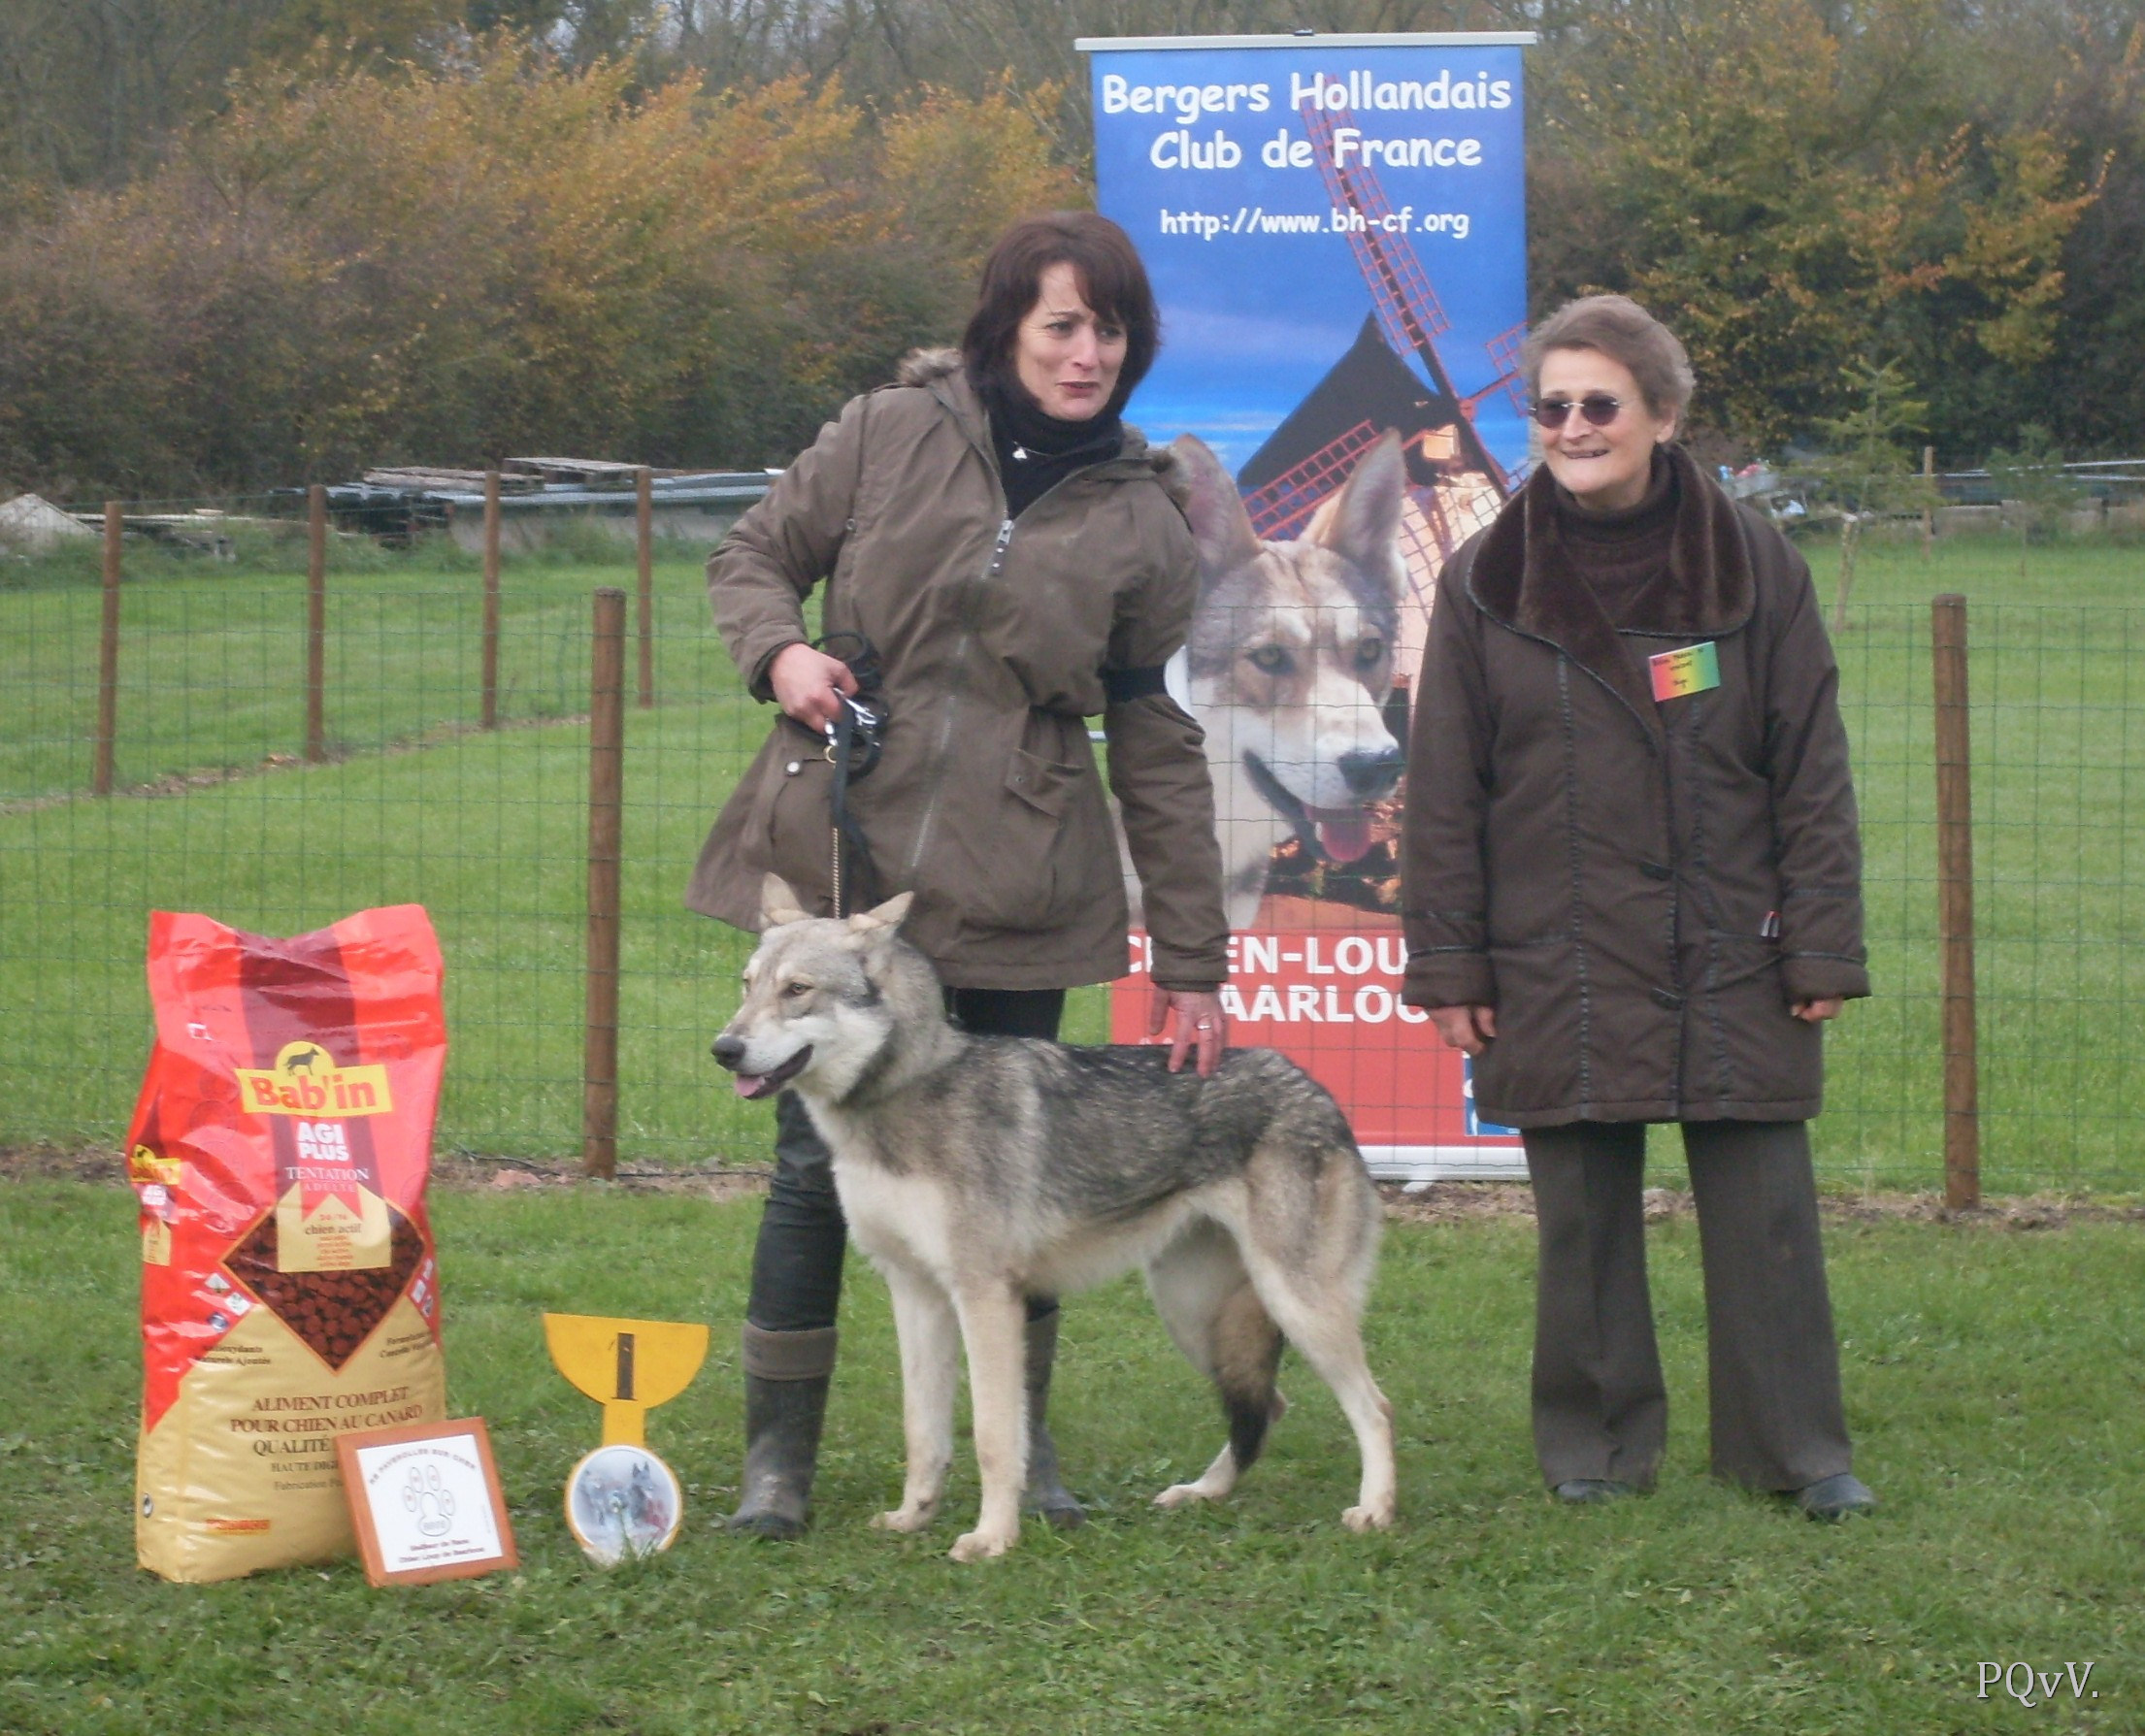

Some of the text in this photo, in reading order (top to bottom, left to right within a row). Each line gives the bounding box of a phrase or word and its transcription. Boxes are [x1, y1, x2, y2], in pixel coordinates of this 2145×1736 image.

[1103, 70, 1511, 124] Bergers Hollandais
[1149, 128, 1482, 170] Club de France
[1160, 207, 1469, 241] http://www.bh-cf.org
[248, 1074, 378, 1111] Bab'in
[298, 1122, 345, 1144] AGI
[298, 1143, 349, 1162] PLUS
[283, 1166, 371, 1181] TENTATION
[252, 1386, 410, 1412] ALIMENT COMPLET
[230, 1404, 423, 1433] POUR CHIEN AU CANARD
[253, 1434, 330, 1457] QUALITÉ
[271, 1461, 311, 1473] HAUTE
